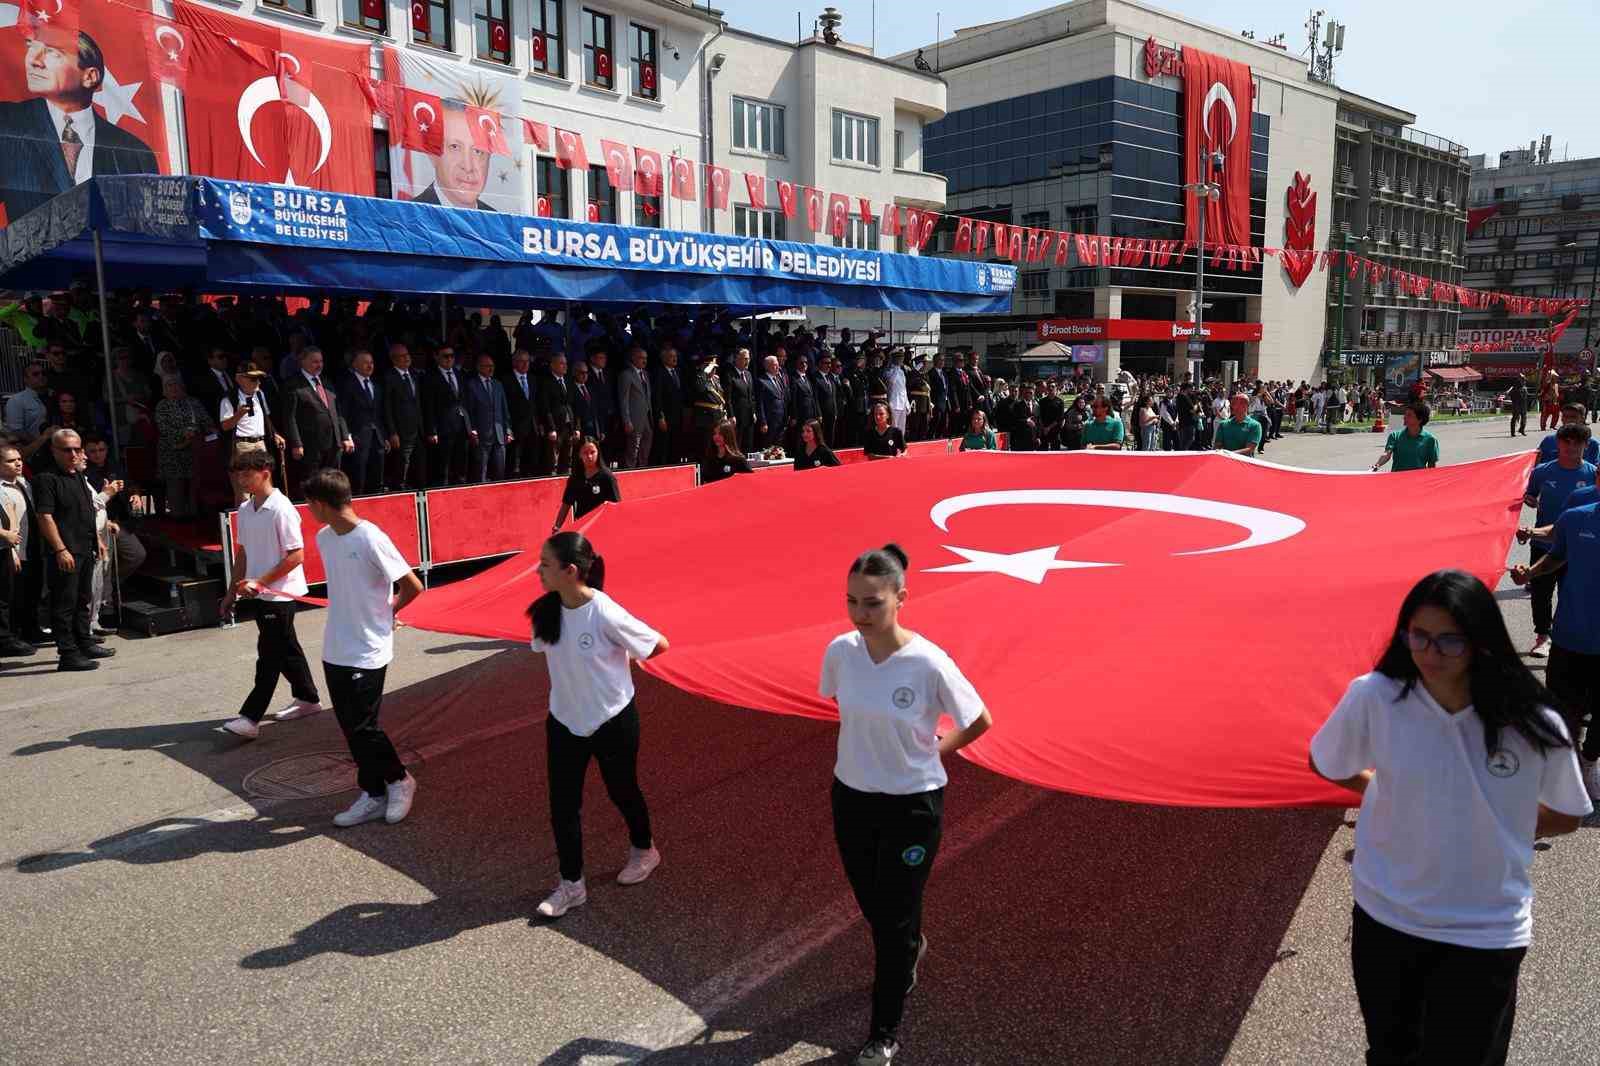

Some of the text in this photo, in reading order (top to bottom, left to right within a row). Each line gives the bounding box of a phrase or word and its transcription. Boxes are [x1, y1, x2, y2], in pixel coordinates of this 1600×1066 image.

[273, 190, 347, 216] BURSA
[274, 207, 347, 229] BÜYÜKŞEHİR
[275, 224, 349, 242] BELEDİYESİ
[522, 227, 882, 283] BURSA BÜYÜKŞEHİR BELEDİYESİ
[1049, 325, 1102, 335] Ziraat Bankası
[1471, 330, 1550, 342] OTOPARK
